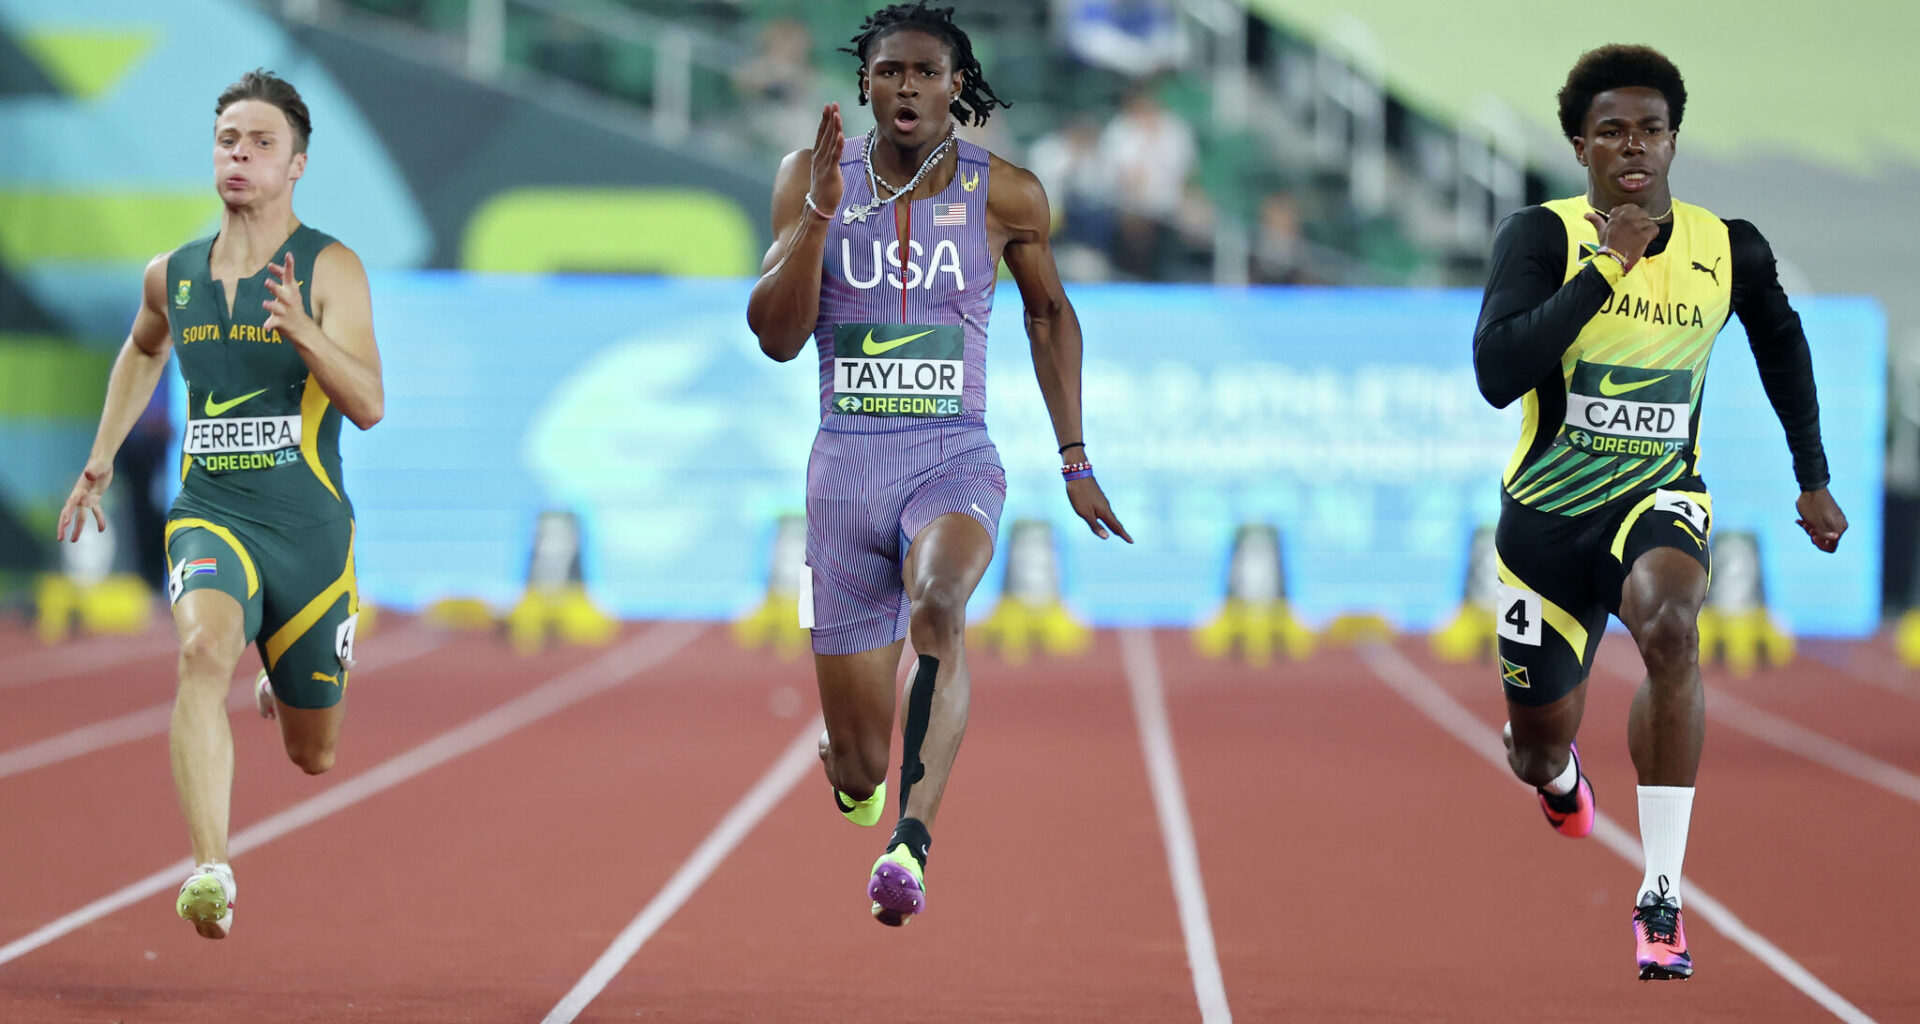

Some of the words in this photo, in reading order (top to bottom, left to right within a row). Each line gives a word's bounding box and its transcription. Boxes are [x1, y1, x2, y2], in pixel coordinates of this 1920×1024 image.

[842, 238, 965, 291] USA
[1600, 291, 1704, 329] JAMAICA
[229, 324, 282, 344] AFRICA
[841, 362, 956, 391] TAYLOR
[862, 397, 959, 414] OREGON26
[1585, 401, 1675, 433] CARD
[190, 420, 294, 449] FERREIRA
[206, 448, 299, 471] OREGON26
[1670, 500, 1694, 518] 4
[1505, 599, 1529, 635] 4
[340, 625, 350, 659] 6
